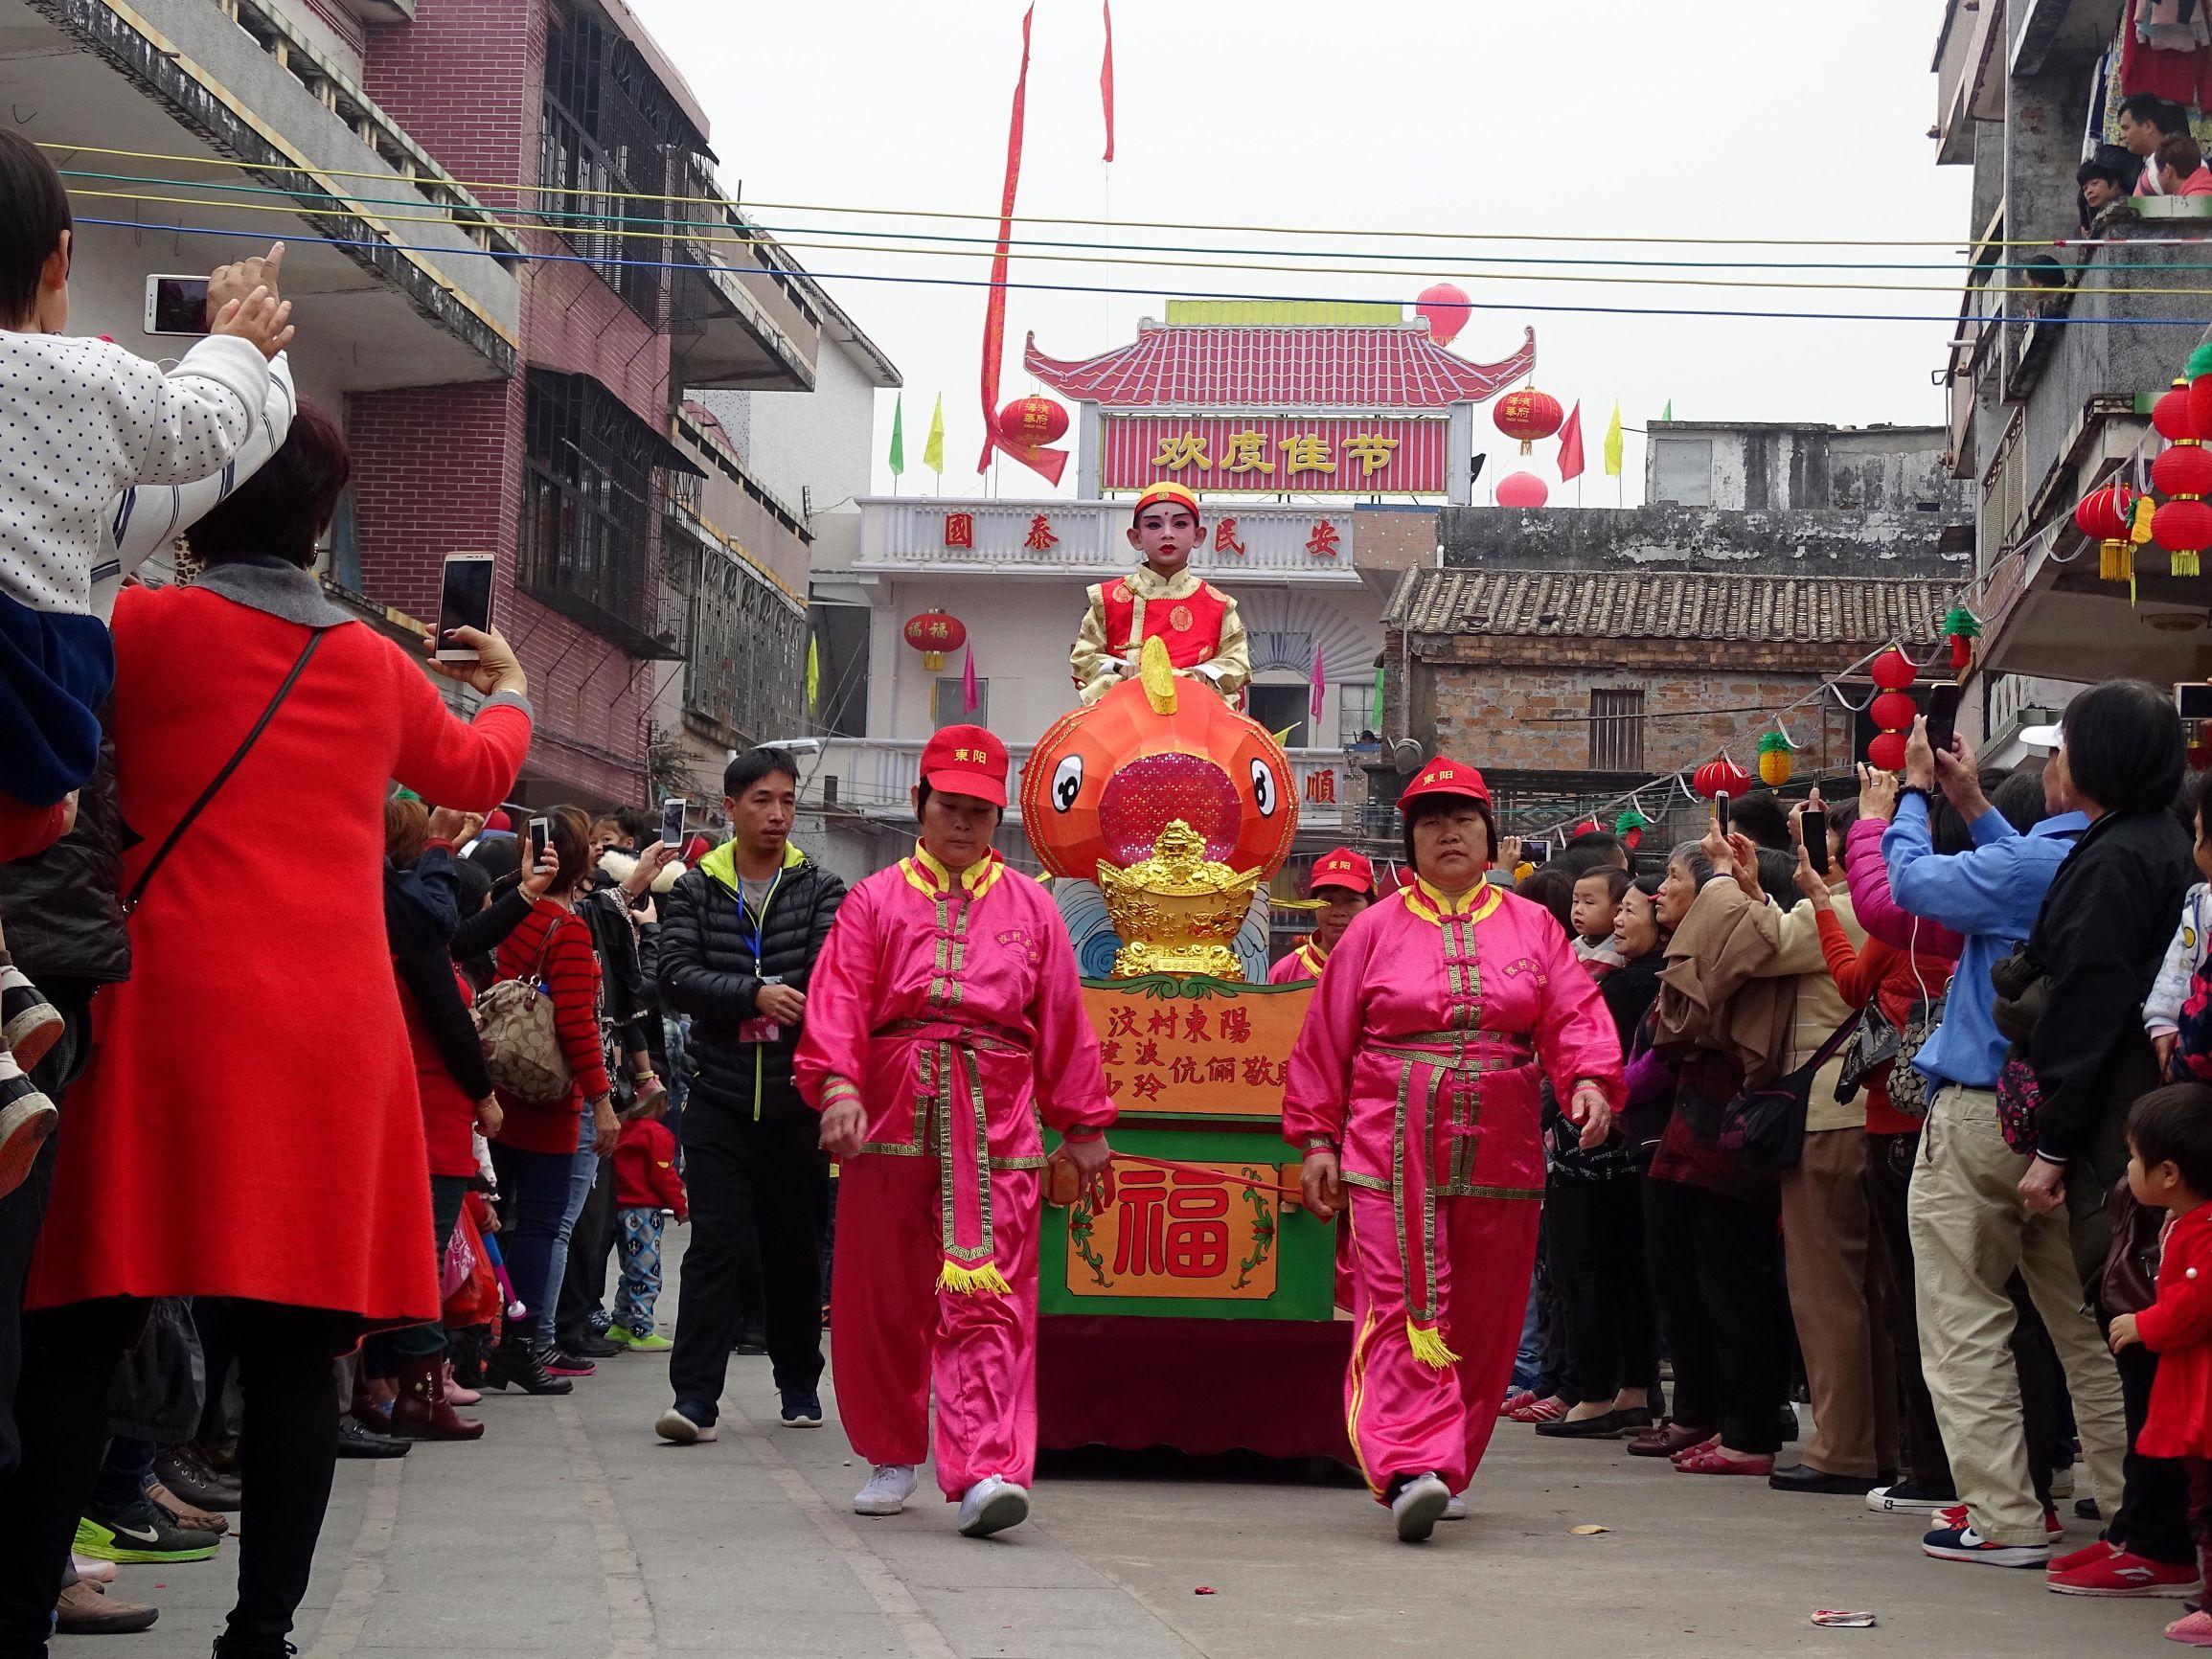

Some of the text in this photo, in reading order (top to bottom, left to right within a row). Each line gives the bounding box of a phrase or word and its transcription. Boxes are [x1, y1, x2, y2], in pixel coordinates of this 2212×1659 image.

[1152, 430, 1399, 477] 欢度佳节
[954, 748, 987, 764] 東阳
[1306, 768, 1337, 805] 順
[1423, 770, 1453, 786] 東阳
[1107, 1004, 1252, 1044] 汶村東陽
[1113, 1170, 1229, 1278] 福
